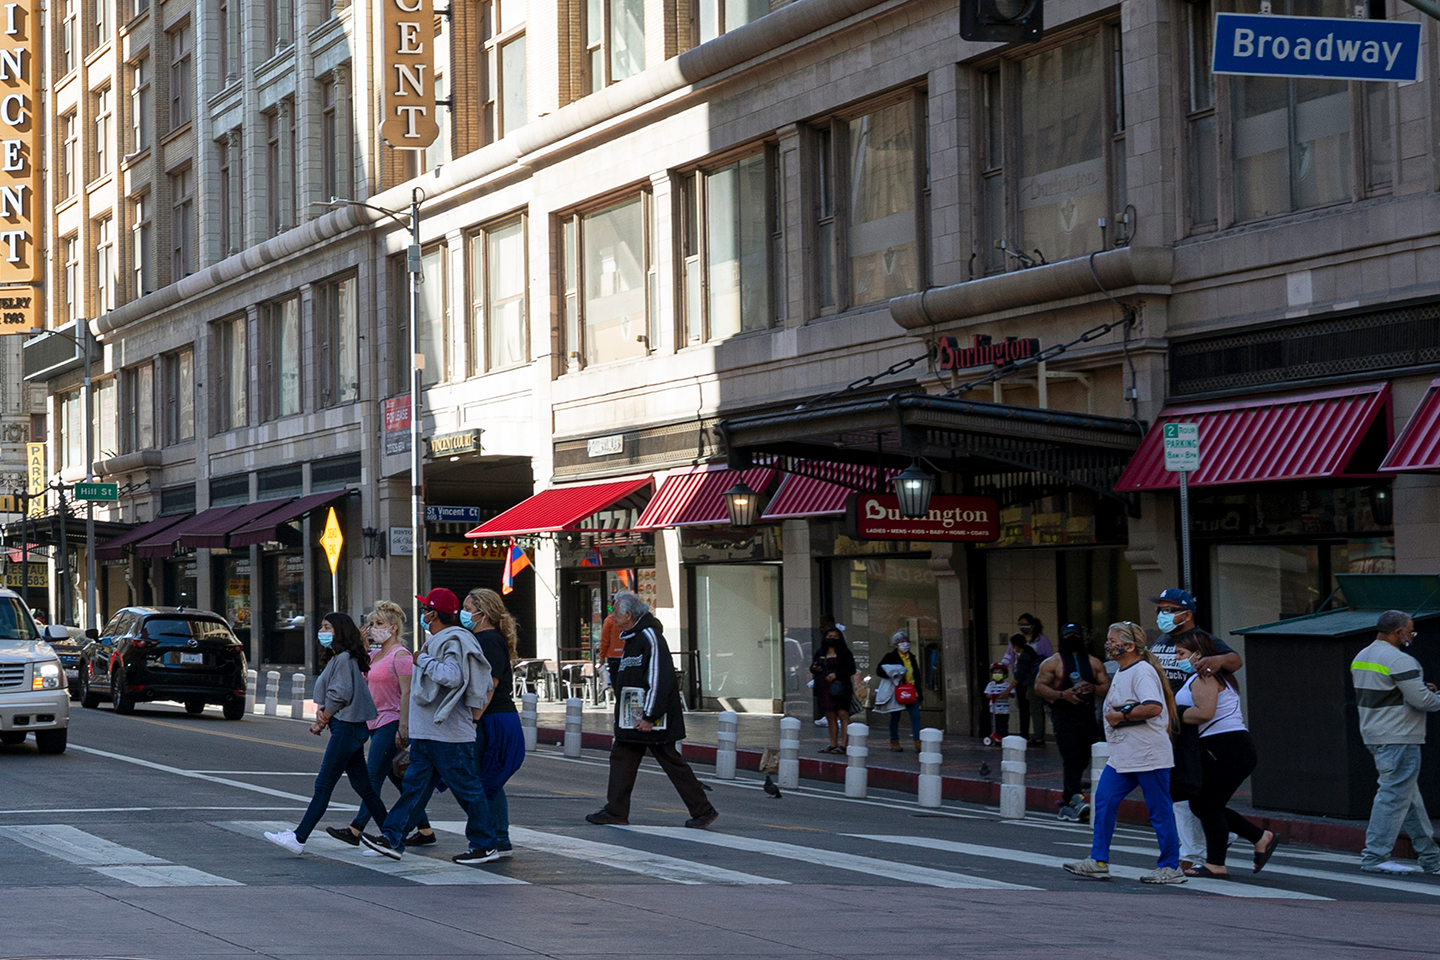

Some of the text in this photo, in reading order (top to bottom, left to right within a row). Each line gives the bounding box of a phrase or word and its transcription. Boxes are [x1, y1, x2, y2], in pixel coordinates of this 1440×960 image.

[1233, 28, 1403, 72] Broadway
[939, 334, 1033, 370] Burlington
[1167, 425, 1175, 437] 2
[1166, 439, 1197, 449] PARKING
[80, 487, 112, 496] Hill St
[426, 507, 478, 517] St Vincent Ct
[865, 499, 989, 528] Bungton
[327, 527, 338, 539] DEAD
[580, 507, 642, 548] PIZZA
[328, 544, 336, 555] END
